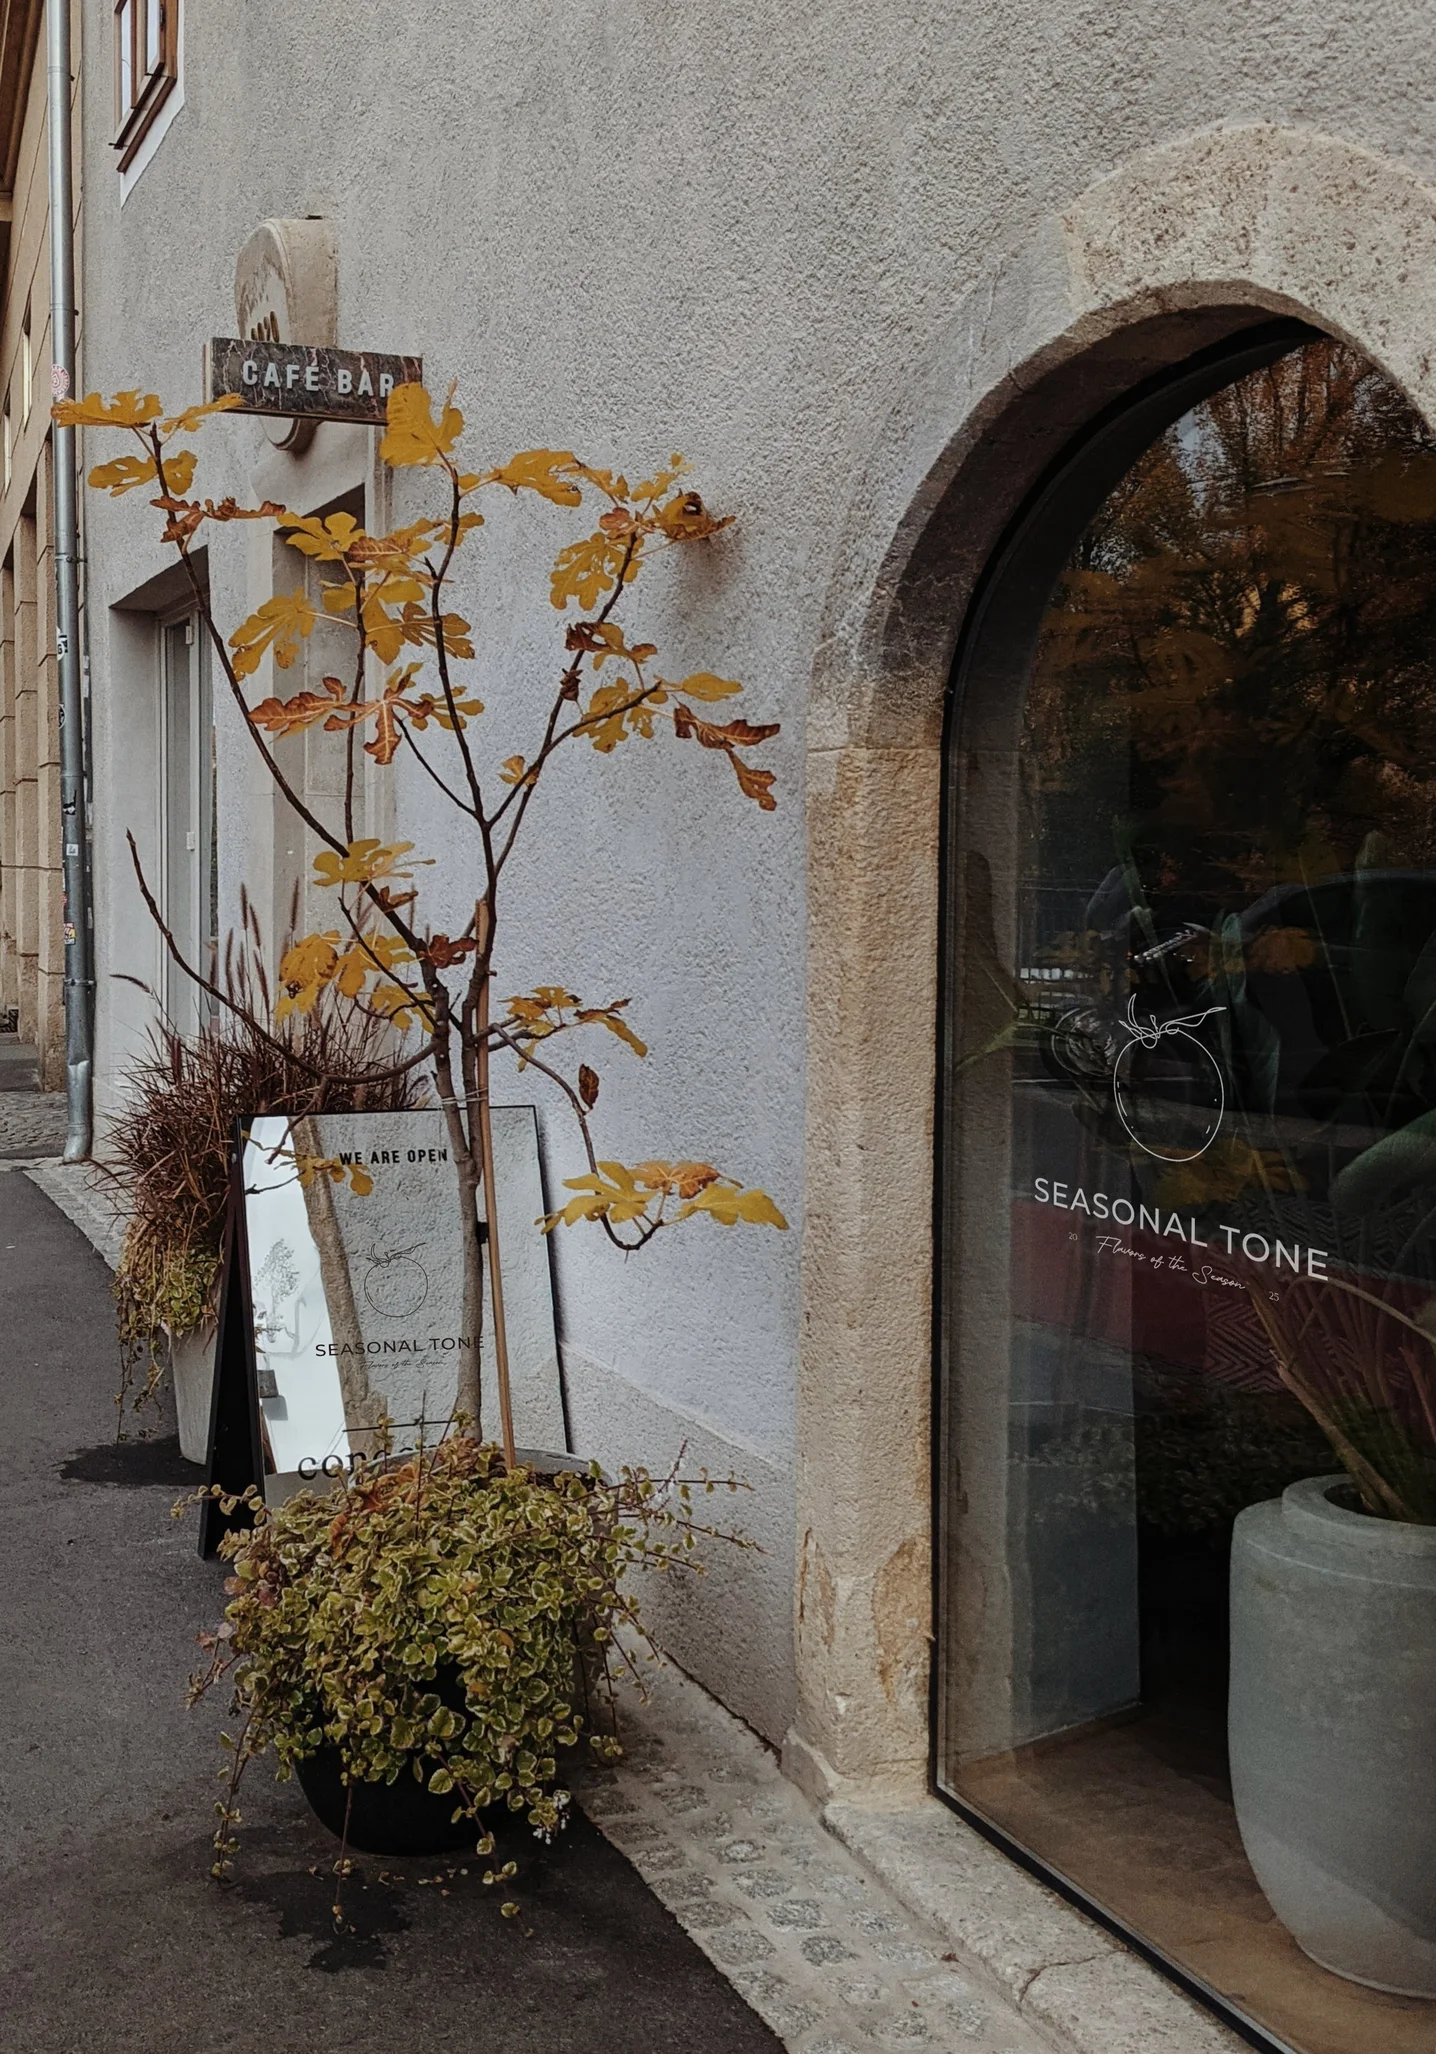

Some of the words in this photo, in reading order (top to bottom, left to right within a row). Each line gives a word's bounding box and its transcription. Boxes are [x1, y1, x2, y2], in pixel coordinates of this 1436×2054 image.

[337, 368, 395, 398] BAR
[339, 1151, 363, 1166] WE
[370, 1150, 401, 1165] ARE
[407, 1148, 448, 1163] OPEN
[1034, 1177, 1208, 1249] SEASONAL
[1219, 1224, 1329, 1281] TONE
[1068, 1231, 1078, 1241] 20
[1095, 1235, 1146, 1261] Flavors
[1150, 1255, 1165, 1269] of
[1168, 1255, 1188, 1272] the
[1191, 1265, 1246, 1290] Season
[1268, 1291, 1280, 1302] 25
[315, 1339, 424, 1357] SEASONAL
[429, 1335, 485, 1351] TONE
